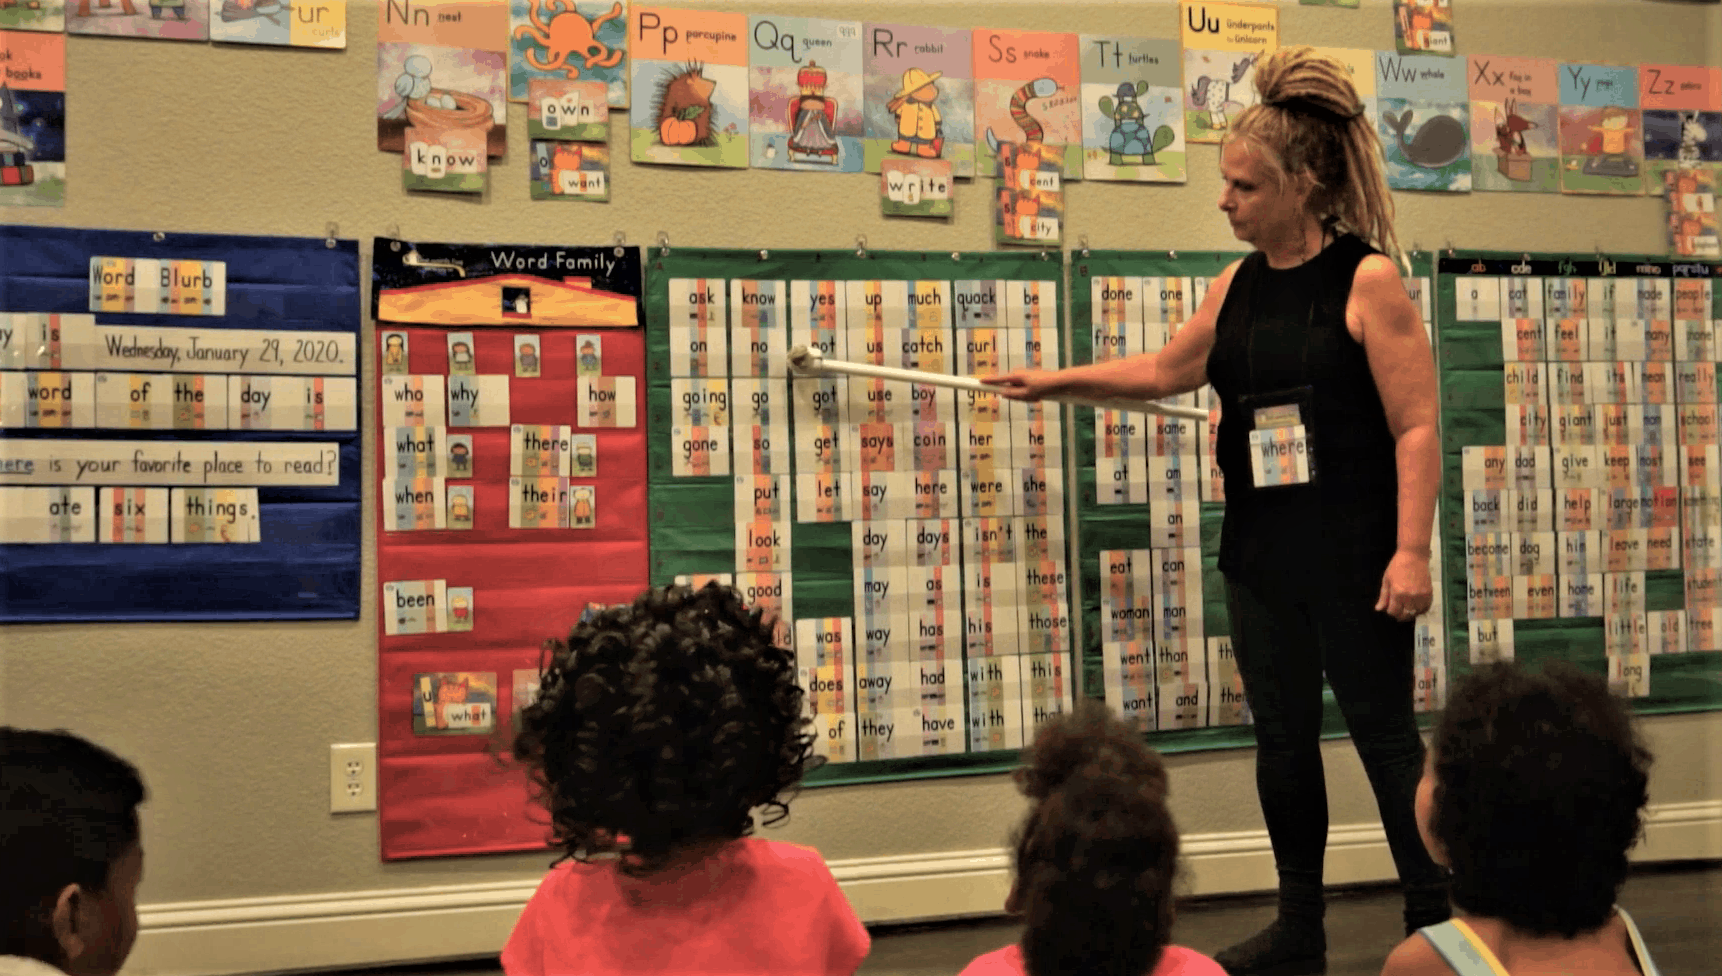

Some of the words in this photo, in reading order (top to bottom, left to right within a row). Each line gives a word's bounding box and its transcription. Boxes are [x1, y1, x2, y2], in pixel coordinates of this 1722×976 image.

[387, 0, 430, 27] Nn
[1188, 6, 1219, 33] Uu
[639, 12, 678, 54] Pp
[754, 20, 802, 63] Qq
[802, 38, 833, 51] queen
[873, 28, 907, 57] Rr
[988, 34, 1017, 63] Ss
[1023, 49, 1050, 60] snake
[1092, 41, 1123, 68] Tt
[1379, 56, 1416, 82] Ww
[1474, 60, 1505, 86] Xx
[1567, 66, 1590, 100] Yy
[1647, 68, 1675, 95] Zz
[547, 104, 589, 116] own
[417, 148, 475, 167] know
[568, 178, 601, 189] want
[889, 181, 946, 194] write
[491, 251, 548, 270] Word
[556, 251, 616, 277] Family
[92, 264, 135, 285] Word
[160, 267, 213, 289] Blurb
[689, 286, 715, 305] ask
[742, 286, 775, 305] know
[908, 287, 941, 305] much
[957, 287, 996, 312] quack
[1101, 284, 1132, 300] done
[1160, 288, 1182, 299] one
[1471, 290, 1478, 300] a
[1508, 287, 1527, 300] cat
[1548, 283, 1585, 305] family
[1604, 284, 1616, 300] if
[810, 293, 835, 312] yes
[865, 293, 882, 312] up
[1095, 329, 1126, 346] from
[1517, 325, 1542, 340] cent
[1555, 324, 1579, 340] feel
[1605, 326, 1616, 341] it
[42, 325, 60, 342] is
[105, 334, 181, 368] Wednesday,
[186, 337, 249, 369] January
[258, 339, 284, 367] 29,
[293, 340, 344, 364] 2020.
[902, 335, 943, 353] catch
[967, 335, 996, 354] curl
[1506, 367, 1538, 384] child
[1557, 367, 1583, 384] find
[1607, 367, 1624, 383] its
[28, 380, 72, 400] word
[130, 382, 151, 401] of
[174, 385, 204, 402] the
[241, 382, 271, 411] day
[307, 385, 323, 404] is
[394, 383, 424, 402] who
[451, 383, 479, 408] why
[589, 384, 616, 402] how
[682, 388, 727, 411] going
[812, 386, 837, 411] got
[867, 388, 892, 402] use
[911, 382, 936, 408] boy
[1105, 423, 1135, 435] some
[1157, 423, 1186, 435] same
[1520, 413, 1546, 432] city
[1559, 412, 1592, 432] giant
[1604, 412, 1627, 432] just
[396, 435, 435, 453] what
[523, 433, 569, 452] there
[814, 431, 839, 456] get
[861, 435, 893, 454] says
[914, 433, 946, 446] coin
[970, 429, 993, 446] her
[683, 438, 718, 460] gone
[1261, 436, 1304, 458] where
[50, 455, 61, 472] is
[76, 458, 120, 481] your
[132, 449, 191, 474] favorite
[204, 452, 243, 483] place
[256, 451, 272, 473] to
[285, 450, 336, 475] read?
[1485, 457, 1505, 474] any
[1515, 453, 1535, 468] dad
[1562, 456, 1588, 474] give
[1604, 453, 1629, 472] keep
[1114, 464, 1128, 481] at
[1166, 469, 1181, 479] am
[818, 480, 841, 497] let
[915, 477, 947, 494] here
[971, 479, 1003, 493] were
[1023, 474, 1046, 491] she
[395, 483, 434, 504] when
[522, 483, 568, 503] their
[754, 481, 779, 505] put
[863, 483, 887, 503] say
[50, 495, 81, 516] ate
[114, 497, 146, 517] six
[186, 496, 256, 524] things.
[1473, 495, 1500, 511] back
[1517, 496, 1537, 512] did
[1564, 495, 1591, 512] help
[1609, 495, 1638, 514] large
[1168, 513, 1183, 525] an
[749, 529, 780, 548] look
[863, 527, 888, 552] day
[917, 526, 949, 550] days
[976, 523, 1013, 541] isn't
[1468, 538, 1508, 556] become
[1520, 542, 1540, 560] dog
[1611, 537, 1639, 551] leave
[1647, 537, 1672, 549] need
[1110, 560, 1132, 574] eat
[1163, 559, 1184, 573] can
[1027, 569, 1064, 585] these
[1613, 577, 1638, 594] life
[747, 578, 782, 605] good
[865, 580, 889, 600] may
[1469, 583, 1510, 599] between
[1528, 586, 1554, 597] even
[1568, 583, 1594, 596] home
[396, 590, 435, 608] been
[1029, 613, 1067, 630] those
[1111, 607, 1149, 620] woman
[1164, 607, 1186, 618] man
[920, 619, 943, 637] has
[1608, 616, 1645, 635] little
[1661, 617, 1679, 633] old
[816, 632, 841, 643] was
[865, 627, 891, 647] way
[1477, 627, 1498, 643] but
[1121, 650, 1150, 665] went
[1160, 646, 1187, 662] than
[1031, 661, 1061, 678] this
[1616, 657, 1642, 680] long
[809, 673, 843, 691] does
[859, 676, 892, 694] away
[1124, 693, 1152, 710] want
[1176, 692, 1198, 706] and
[450, 704, 487, 722] what
[922, 713, 955, 731] have
[972, 707, 1004, 728] with
[862, 720, 894, 742] they
